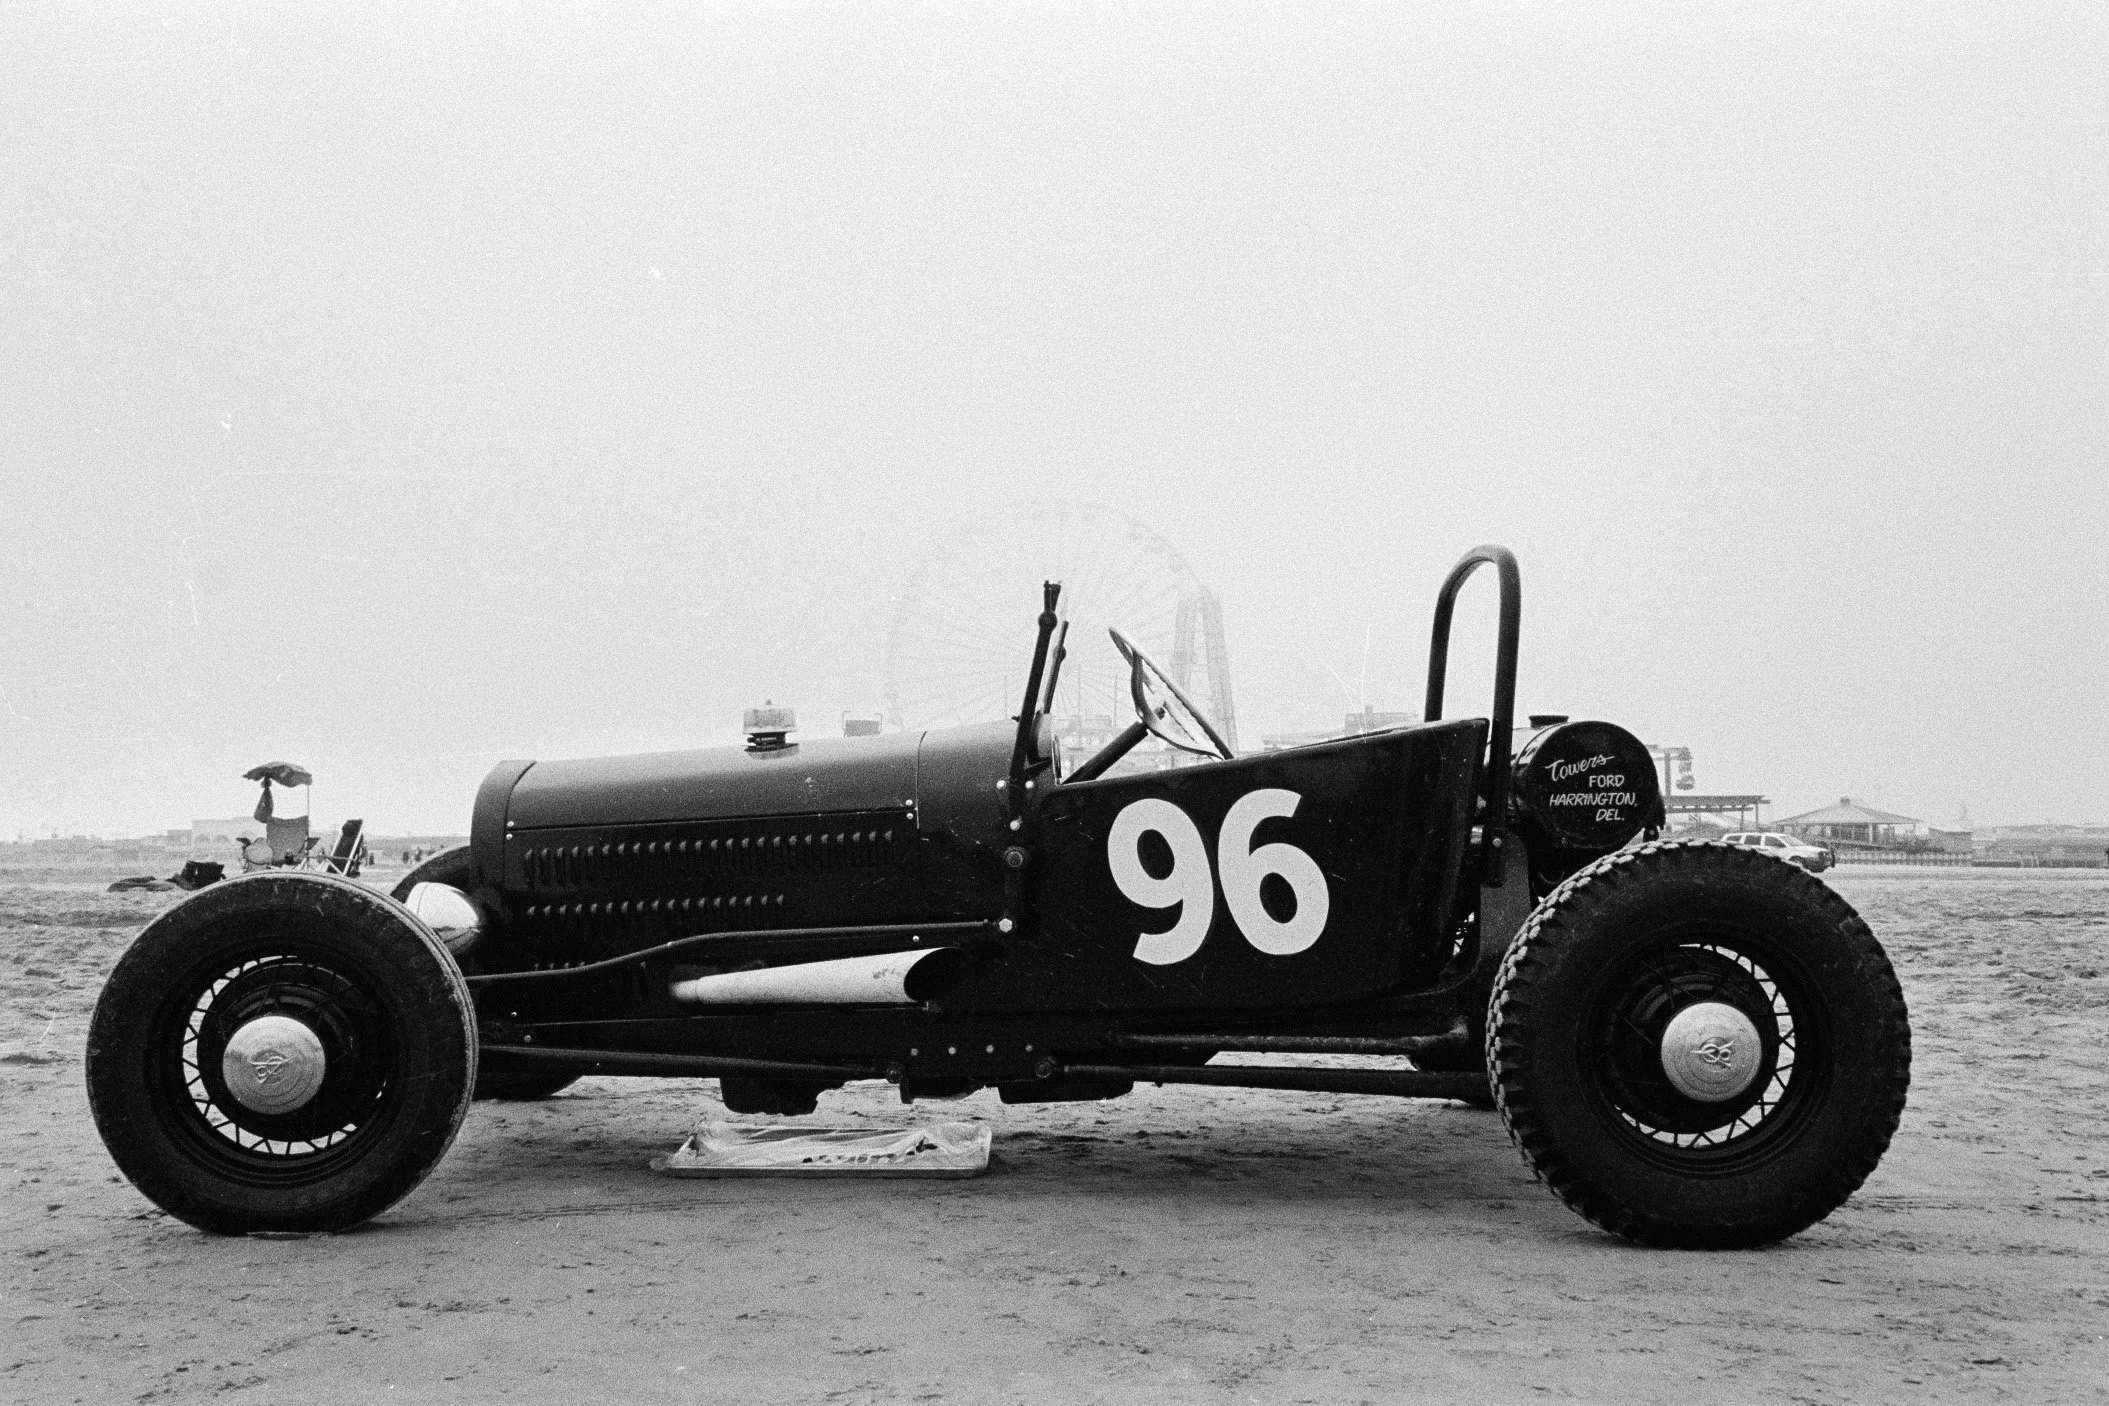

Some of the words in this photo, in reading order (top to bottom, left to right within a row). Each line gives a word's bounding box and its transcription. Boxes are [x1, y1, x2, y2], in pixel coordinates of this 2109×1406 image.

[1544, 754, 1615, 782] Towers
[1589, 775, 1625, 788] FORD
[1595, 808, 1625, 822] DEL.
[1107, 788, 1330, 966] 96
